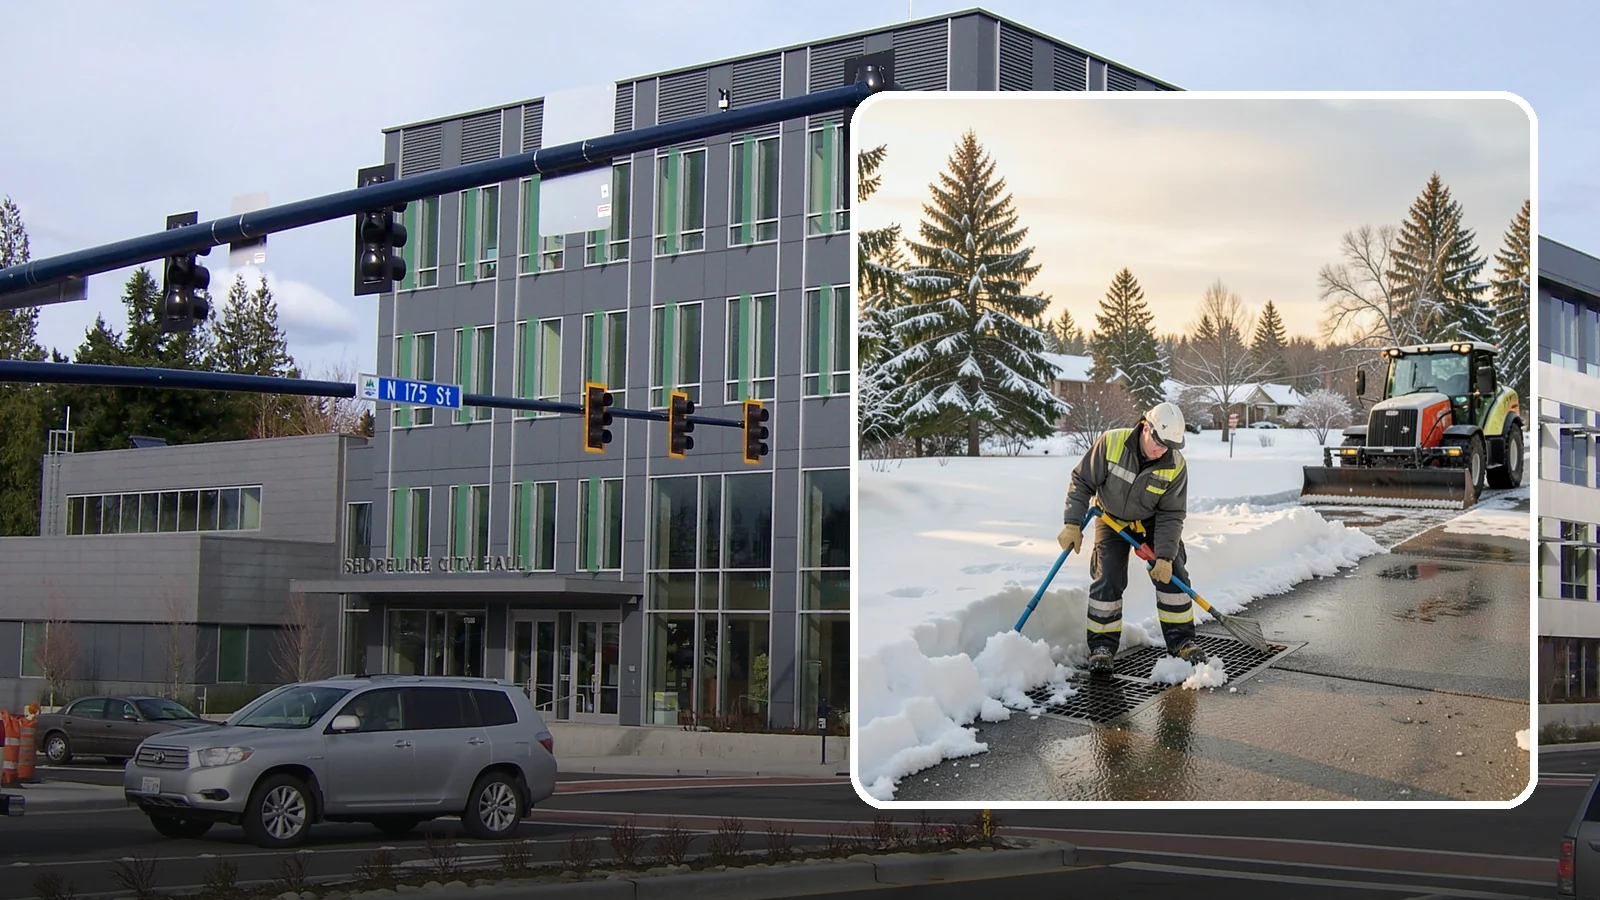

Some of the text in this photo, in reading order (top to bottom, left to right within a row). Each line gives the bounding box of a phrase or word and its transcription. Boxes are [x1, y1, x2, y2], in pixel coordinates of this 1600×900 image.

[387, 380, 452, 406] N 175 St
[344, 554, 525, 574] SHORELINE CITY HALL
